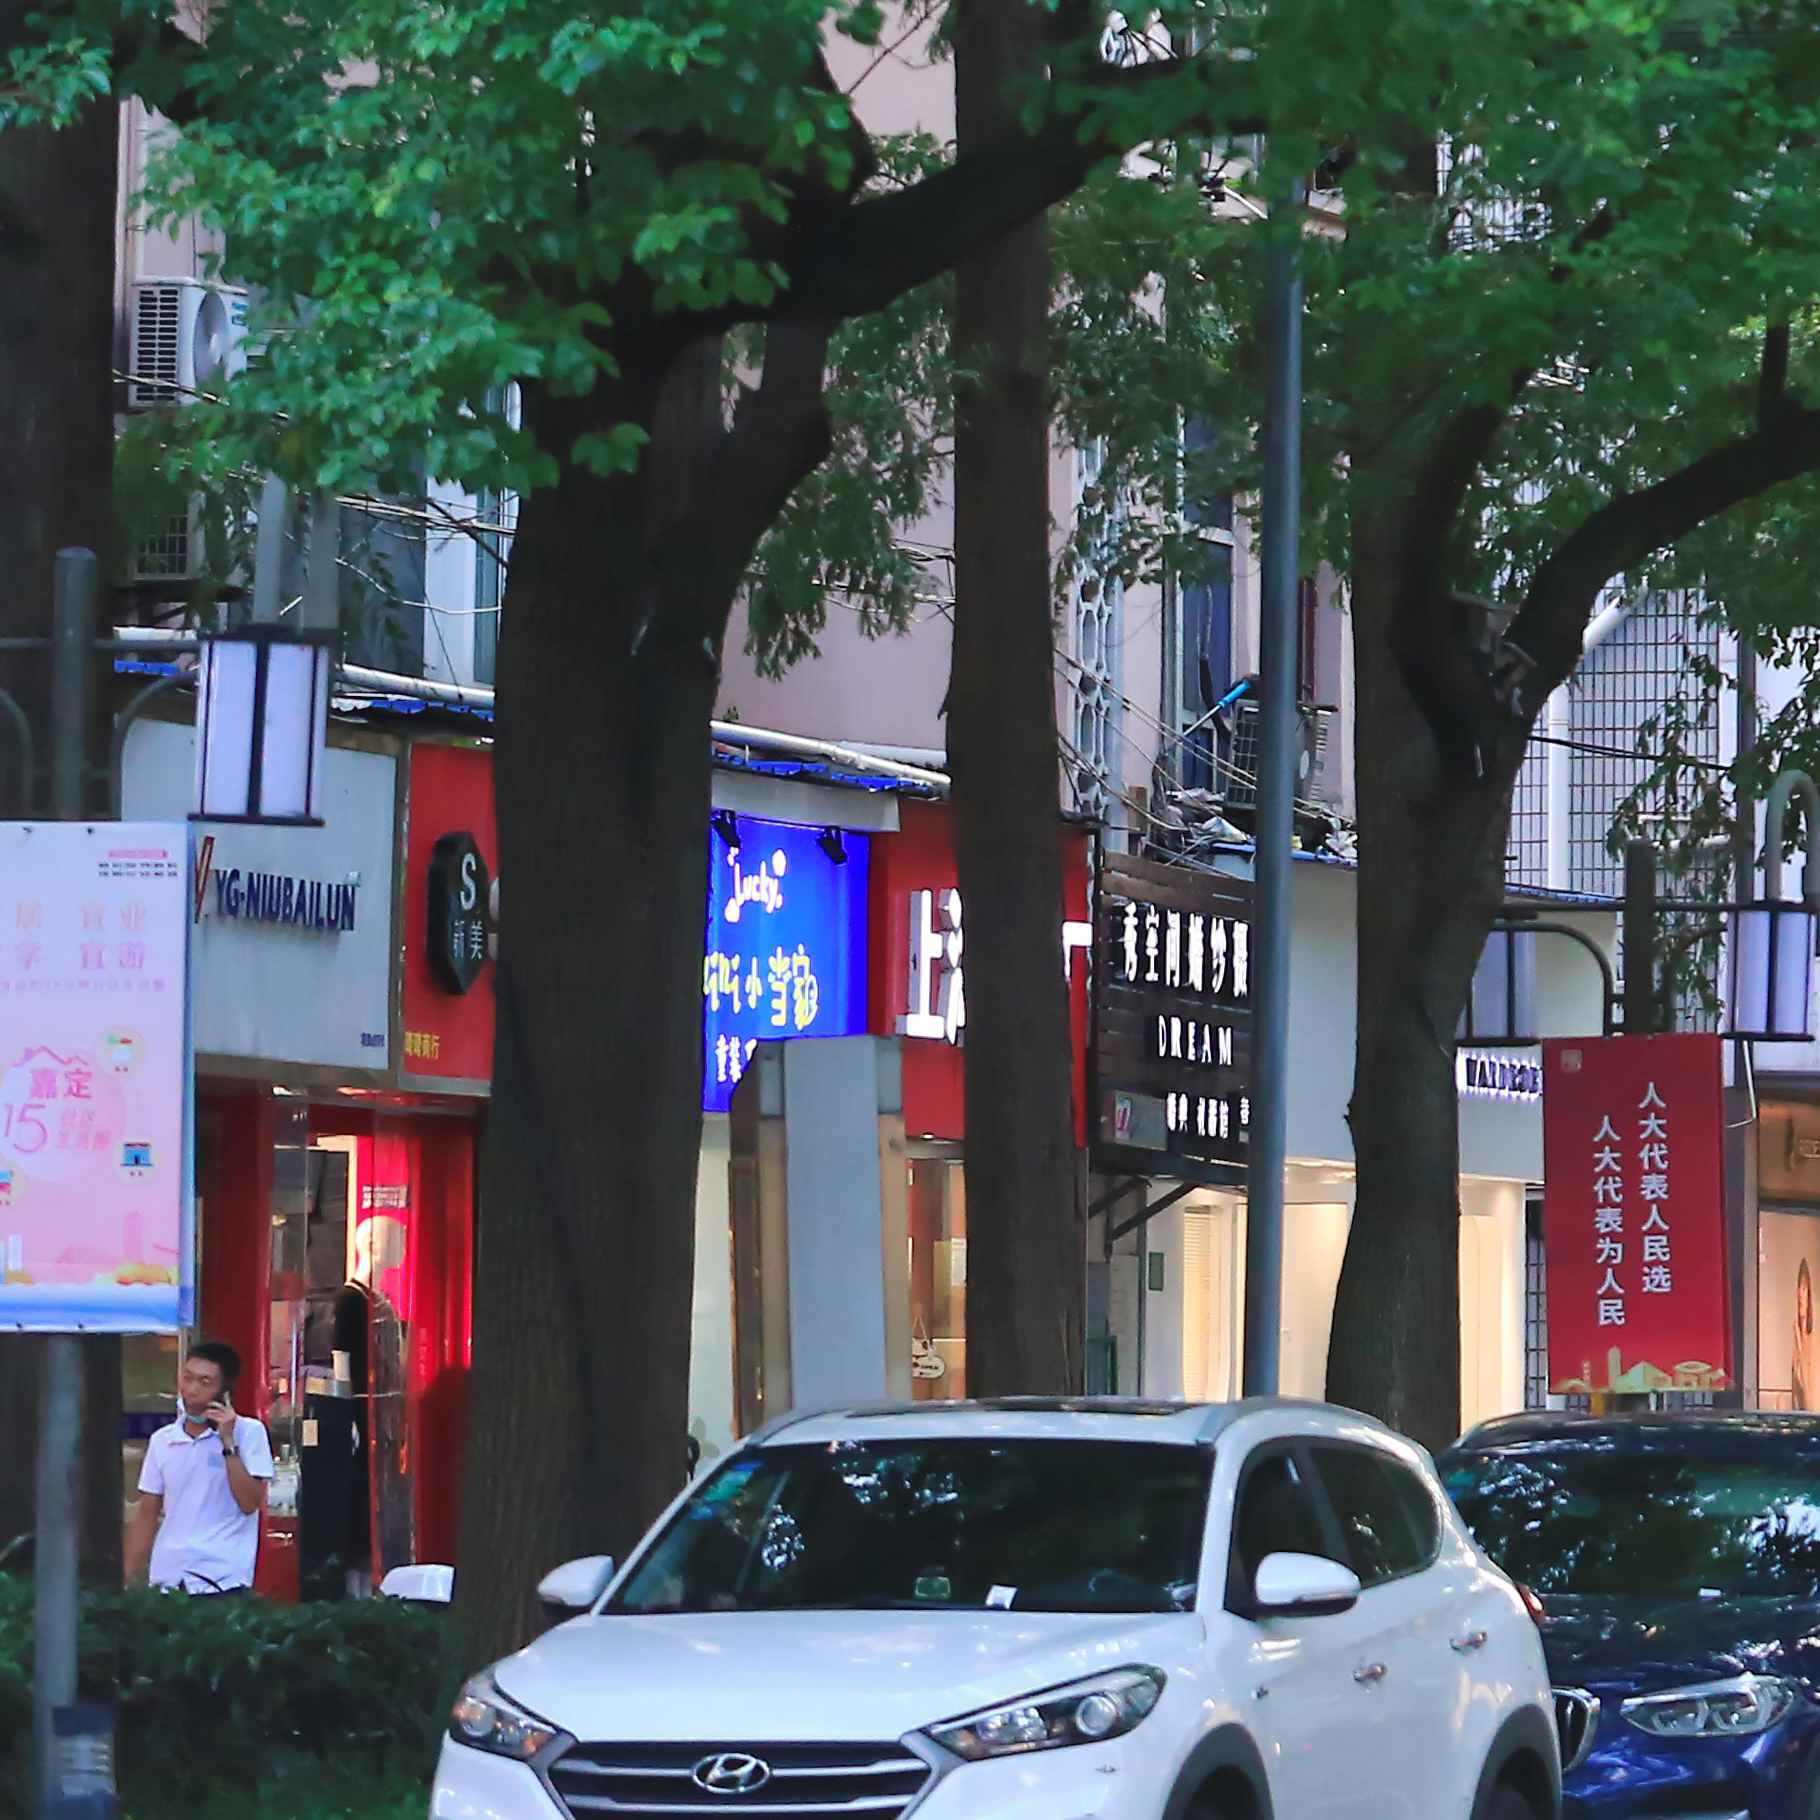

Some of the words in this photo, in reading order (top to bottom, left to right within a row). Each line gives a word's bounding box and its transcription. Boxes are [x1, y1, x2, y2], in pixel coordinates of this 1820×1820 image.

[213, 868, 357, 930] YG-NIUBAILUN
[459, 852, 477, 911] S
[736, 862, 779, 913] Lucky
[1158, 1015, 1232, 1065] DREAM
[30, 1068, 92, 1099] 嘉定
[4, 1103, 47, 1153] 15
[1639, 1082, 1671, 1293] 人大代表人民选
[1593, 1115, 1626, 1326] 人大代表为人民
